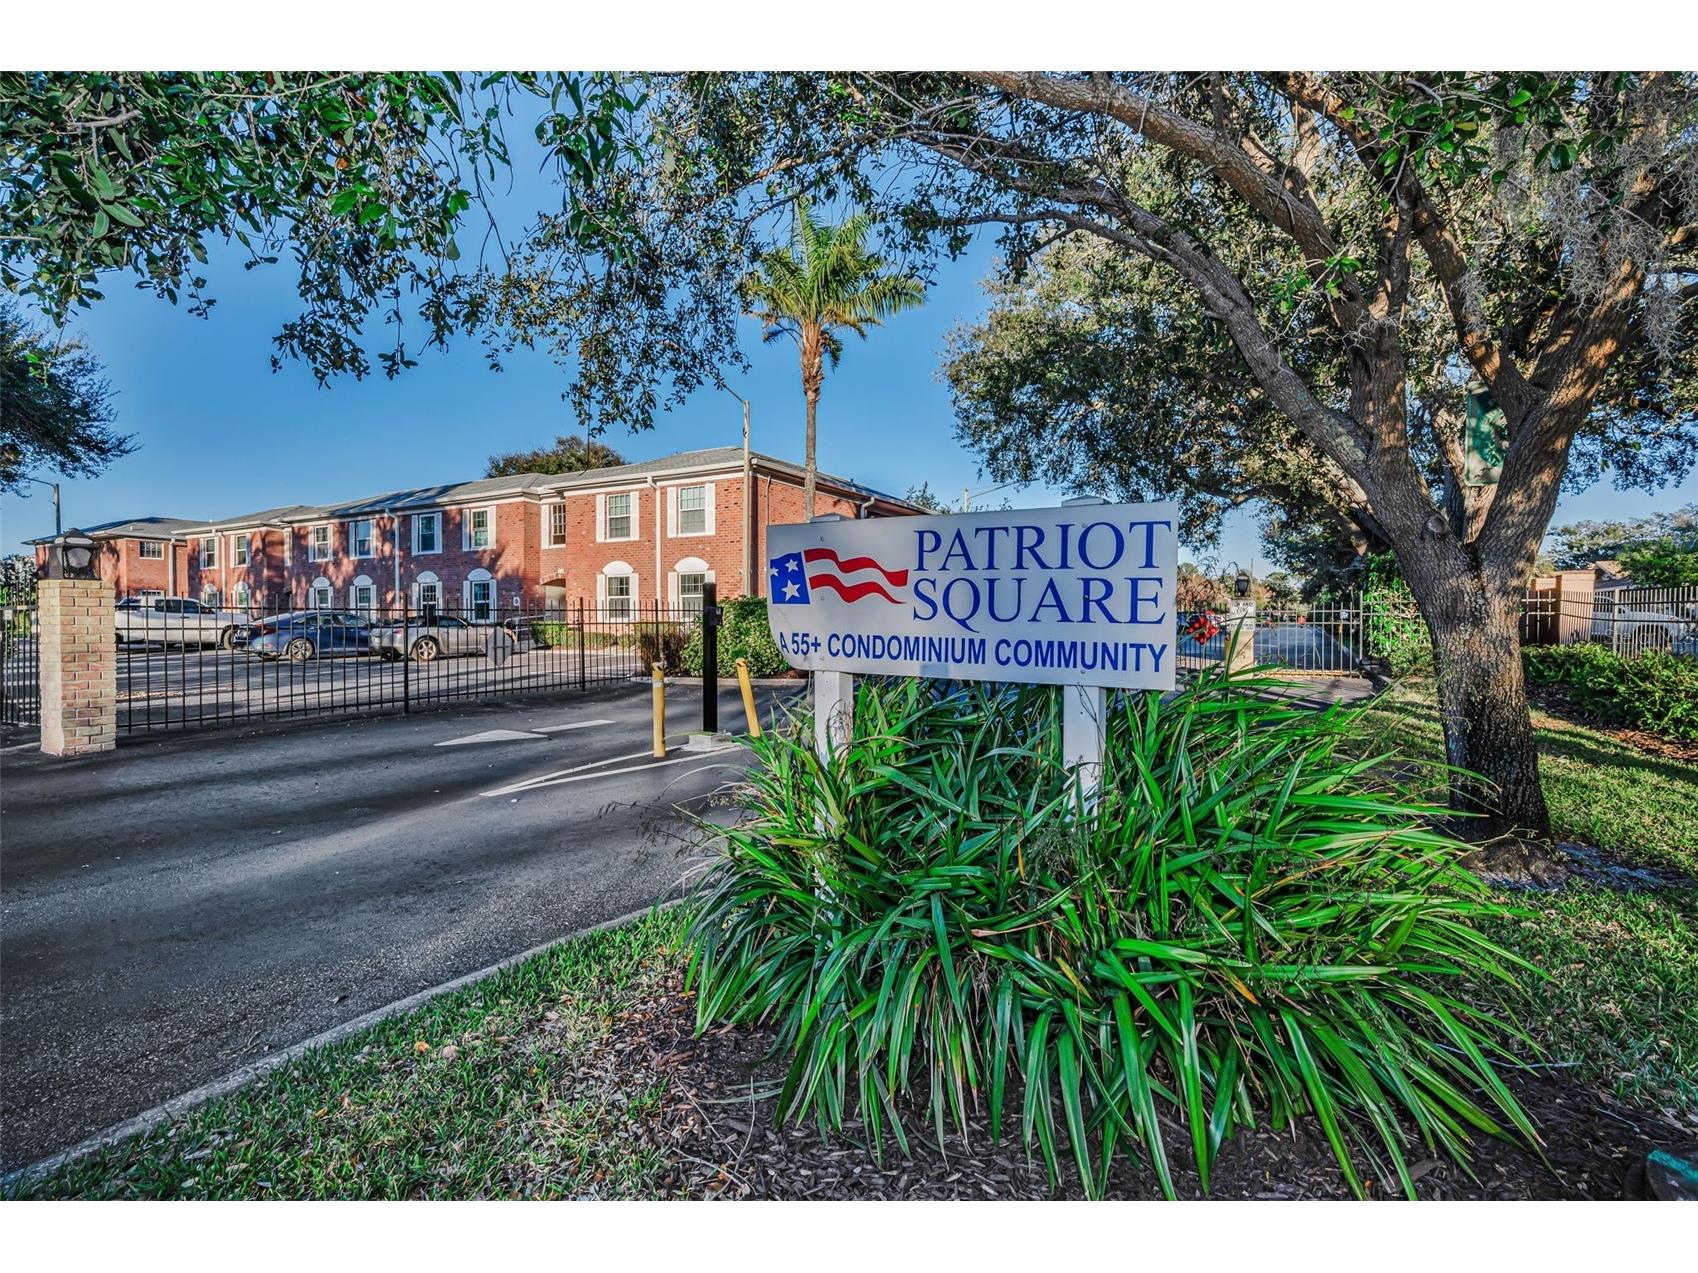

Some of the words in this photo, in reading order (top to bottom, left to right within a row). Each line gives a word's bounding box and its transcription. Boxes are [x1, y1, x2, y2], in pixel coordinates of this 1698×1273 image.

[913, 520, 1172, 571] PATRIOT
[912, 576, 1167, 634] SQUARE
[779, 631, 790, 654] A
[791, 632, 822, 656] 55+
[827, 633, 987, 665] CONDOMINIUM
[994, 638, 1168, 673] COMMUNITY
